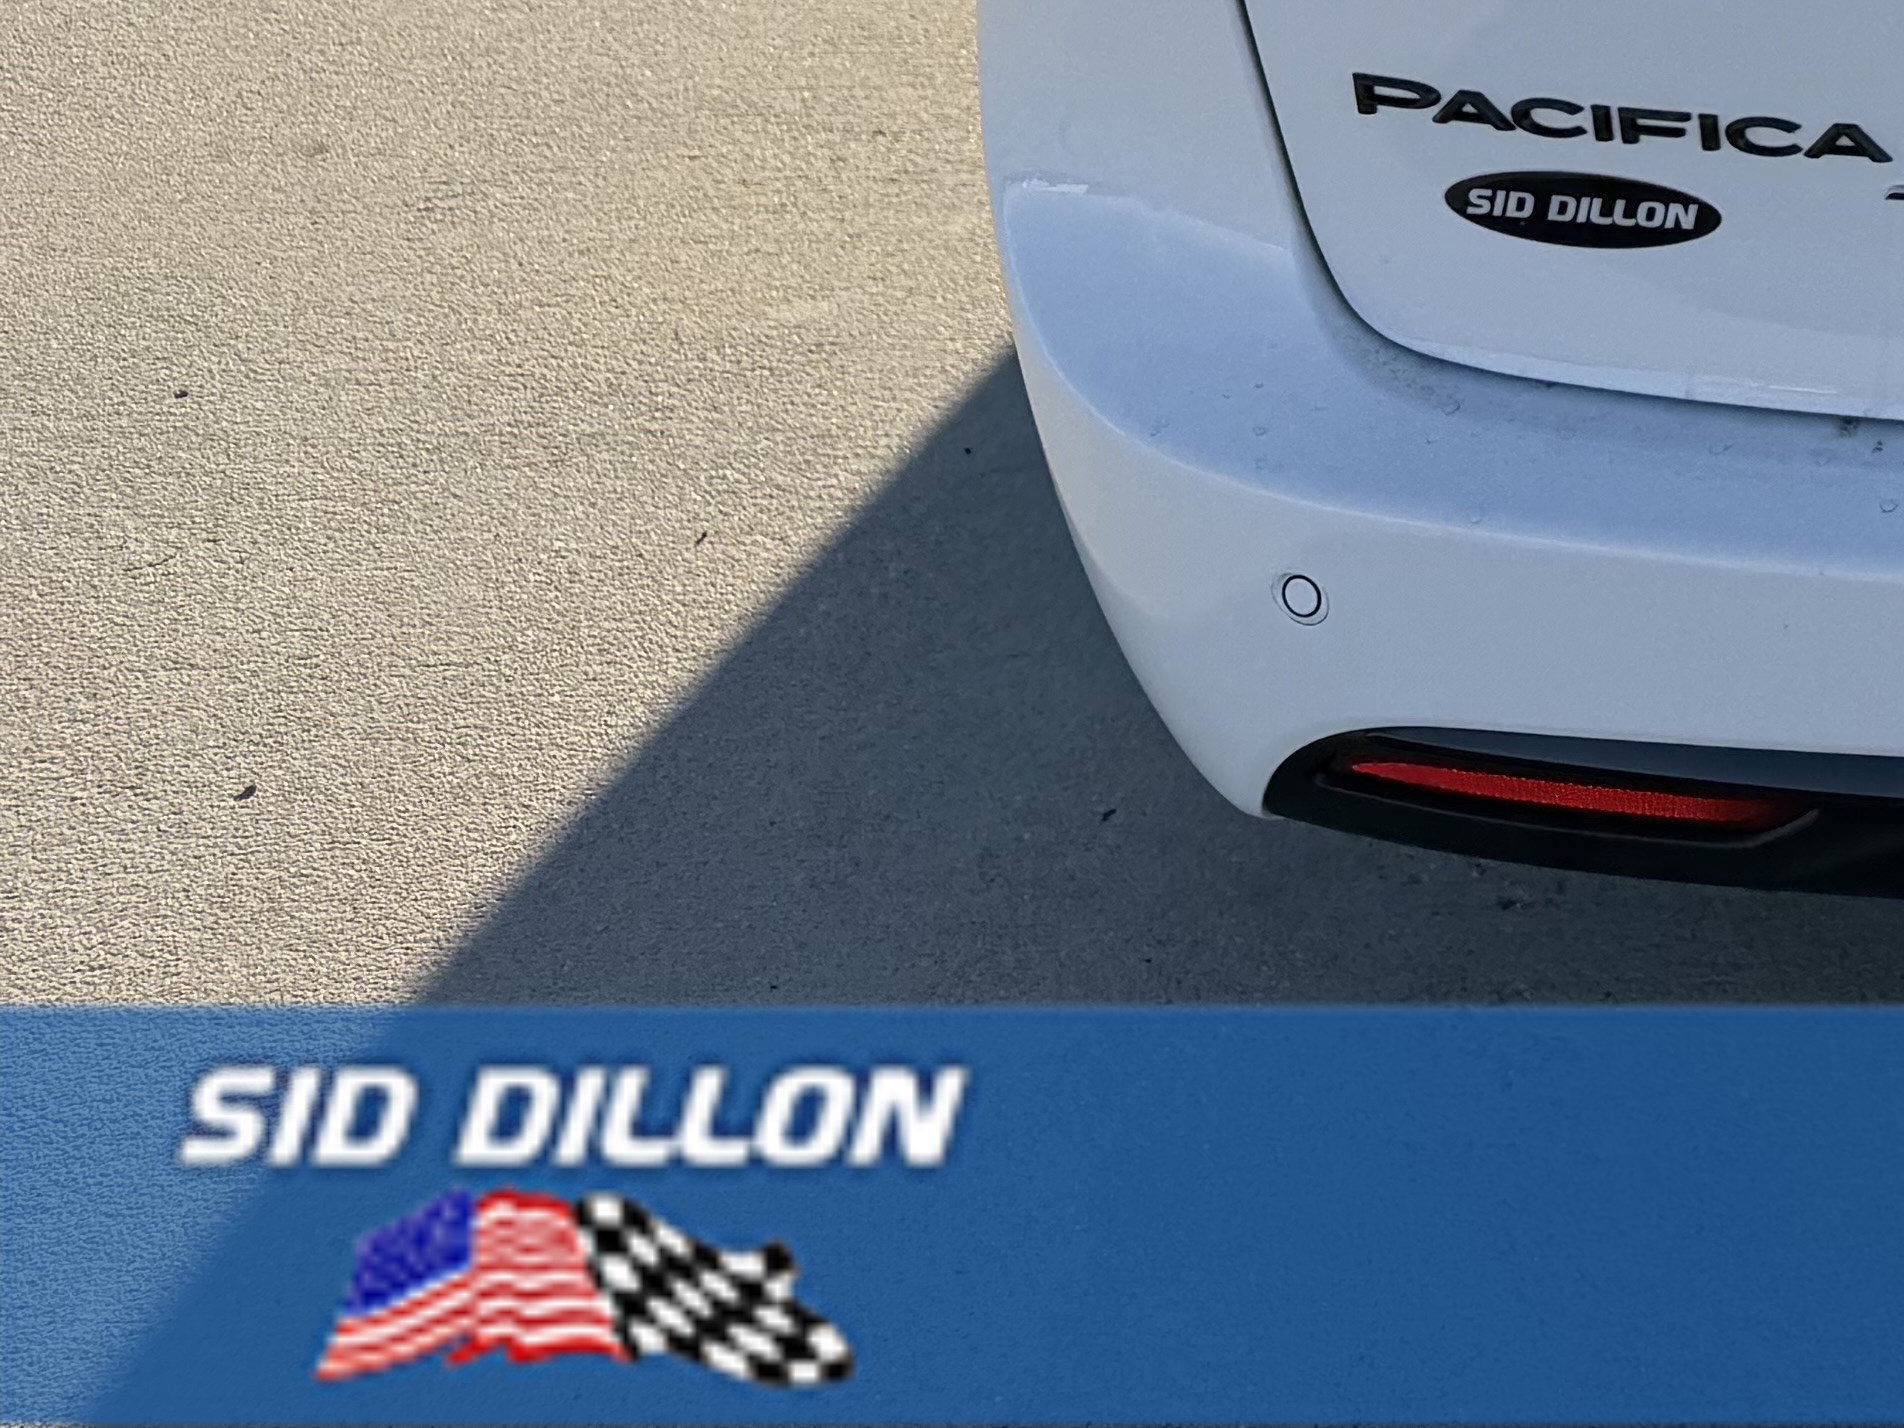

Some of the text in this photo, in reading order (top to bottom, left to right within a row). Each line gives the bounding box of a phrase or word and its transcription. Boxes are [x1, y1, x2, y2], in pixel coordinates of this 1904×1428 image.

[1350, 71, 1894, 165] PACIFICA
[1466, 187, 1699, 231] SID DILLON
